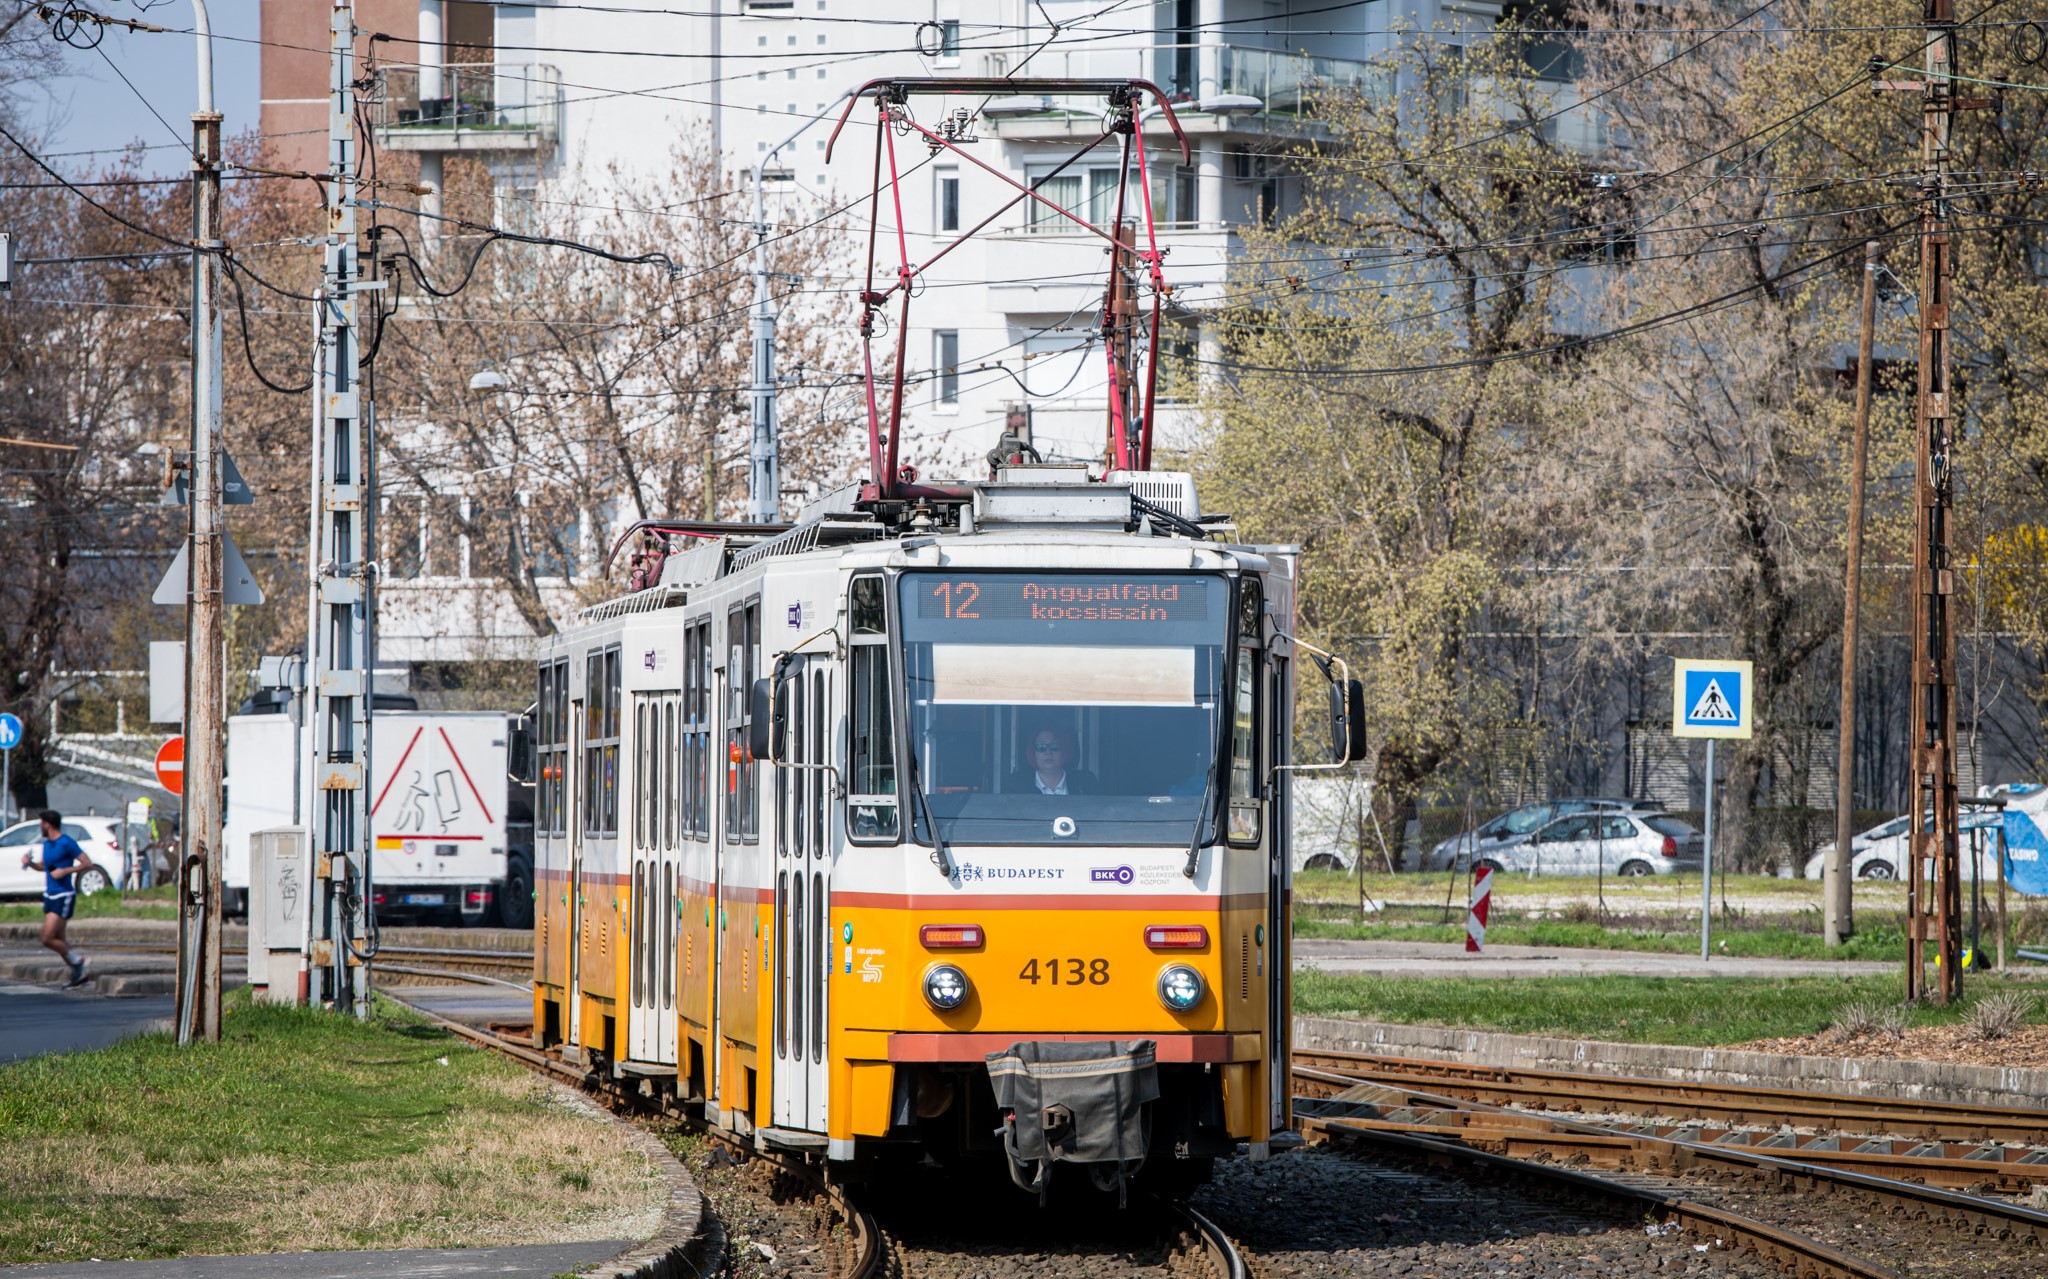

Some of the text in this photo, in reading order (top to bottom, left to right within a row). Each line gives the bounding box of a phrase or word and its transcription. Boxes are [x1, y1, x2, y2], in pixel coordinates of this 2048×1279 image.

[933, 582, 980, 618] 12
[1022, 583, 1178, 602] Angyalföld
[1031, 603, 1167, 620] kocsiszín
[987, 868, 1065, 879] BUDAPEST
[1095, 871, 1116, 879] BKK
[1019, 958, 1110, 985] 4138
